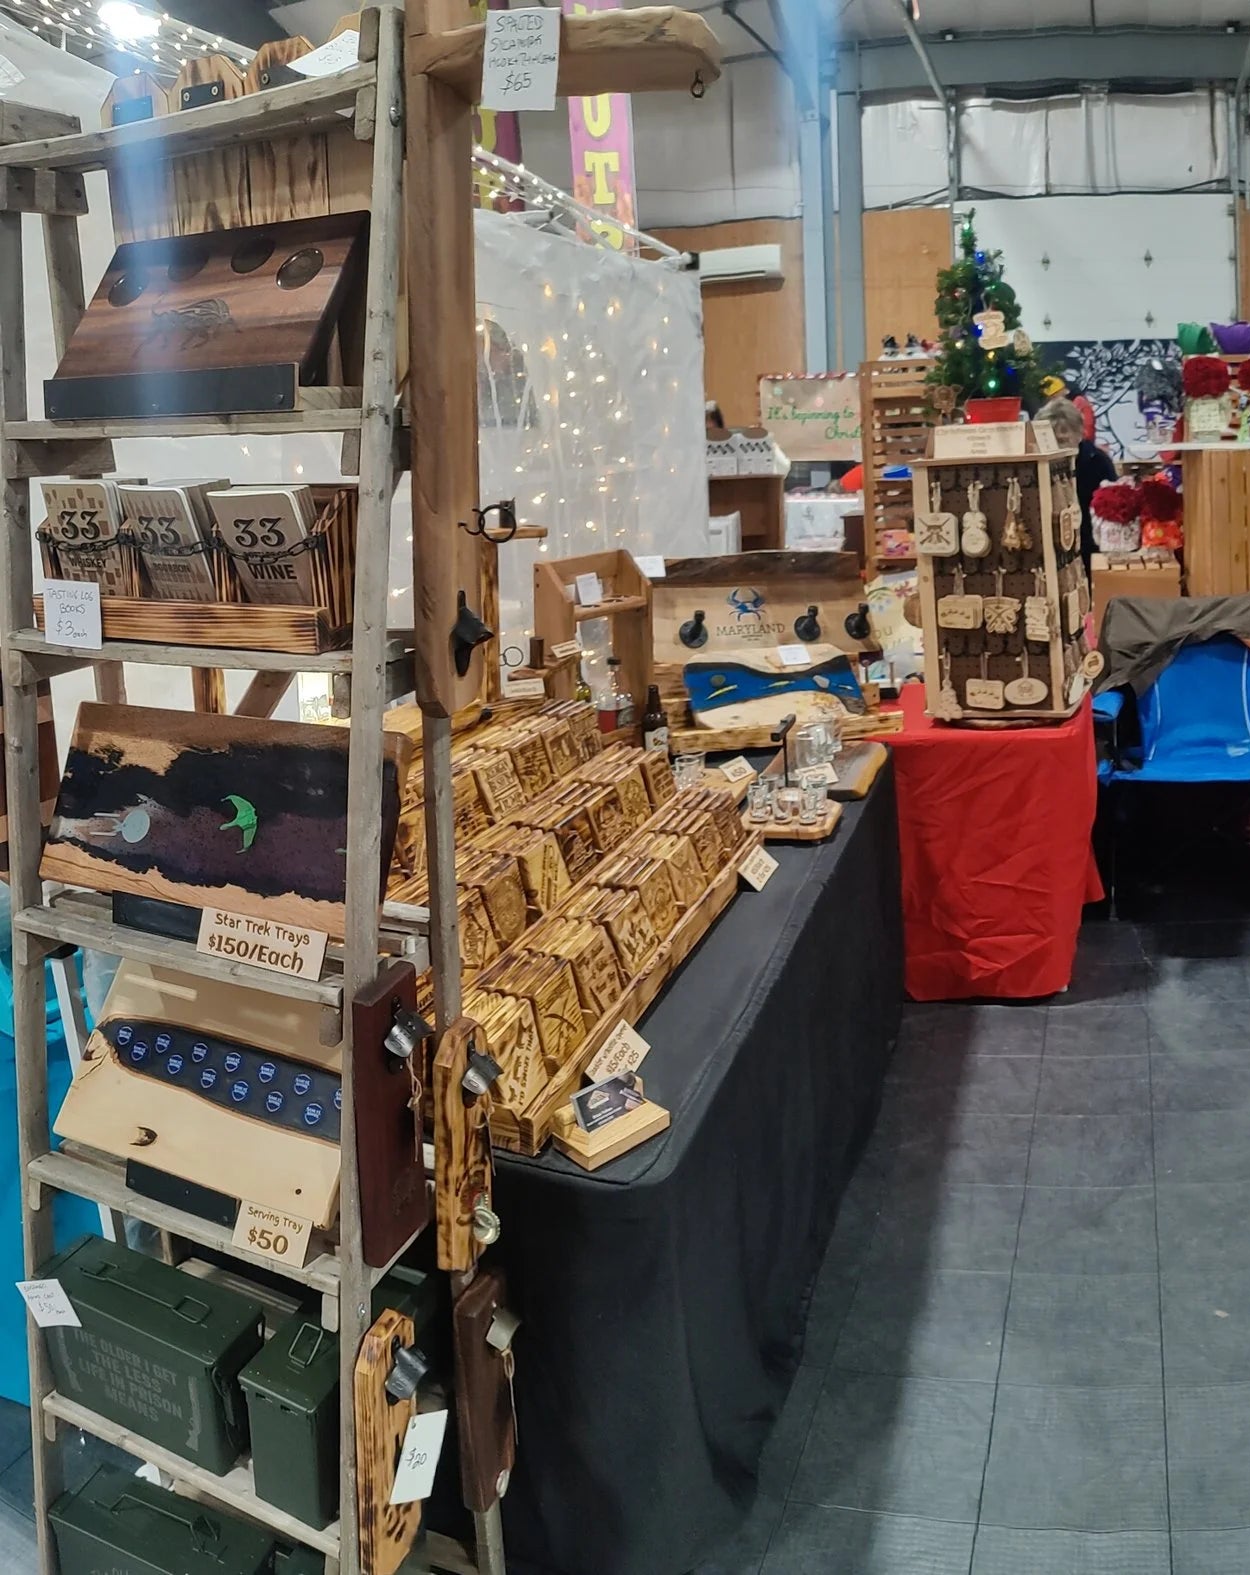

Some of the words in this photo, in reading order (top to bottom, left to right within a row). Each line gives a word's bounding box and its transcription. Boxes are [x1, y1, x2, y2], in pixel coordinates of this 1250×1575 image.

[500, 71, 532, 95] $65
[788, 406, 840, 423] beginning
[842, 408, 855, 420] to
[59, 510, 101, 541] 33
[137, 515, 181, 547] 33
[233, 517, 285, 548] 33
[249, 564, 298, 580] WINE
[46, 587, 79, 600] TASTING
[58, 603, 87, 615] BOOKS
[715, 622, 787, 638] MARYLAND
[214, 912, 242, 930] Star
[245, 919, 272, 937] Trek
[275, 925, 311, 949] Trays
[207, 933, 304, 974] $150/Each
[247, 1206, 281, 1227] Serving
[283, 1217, 304, 1235] Tray
[247, 1226, 289, 1256] $50
[73, 1329, 97, 1348] THE
[99, 1338, 142, 1368] OLDER
[153, 1364, 178, 1387] GET
[95, 1351, 124, 1374] THE
[124, 1365, 163, 1393] LESS
[78, 1357, 110, 1382] LIFE
[110, 1373, 126, 1390] IN
[128, 1378, 184, 1419] PRISON
[103, 1385, 160, 1423] MEANS
[404, 1447, 428, 1470] $20
